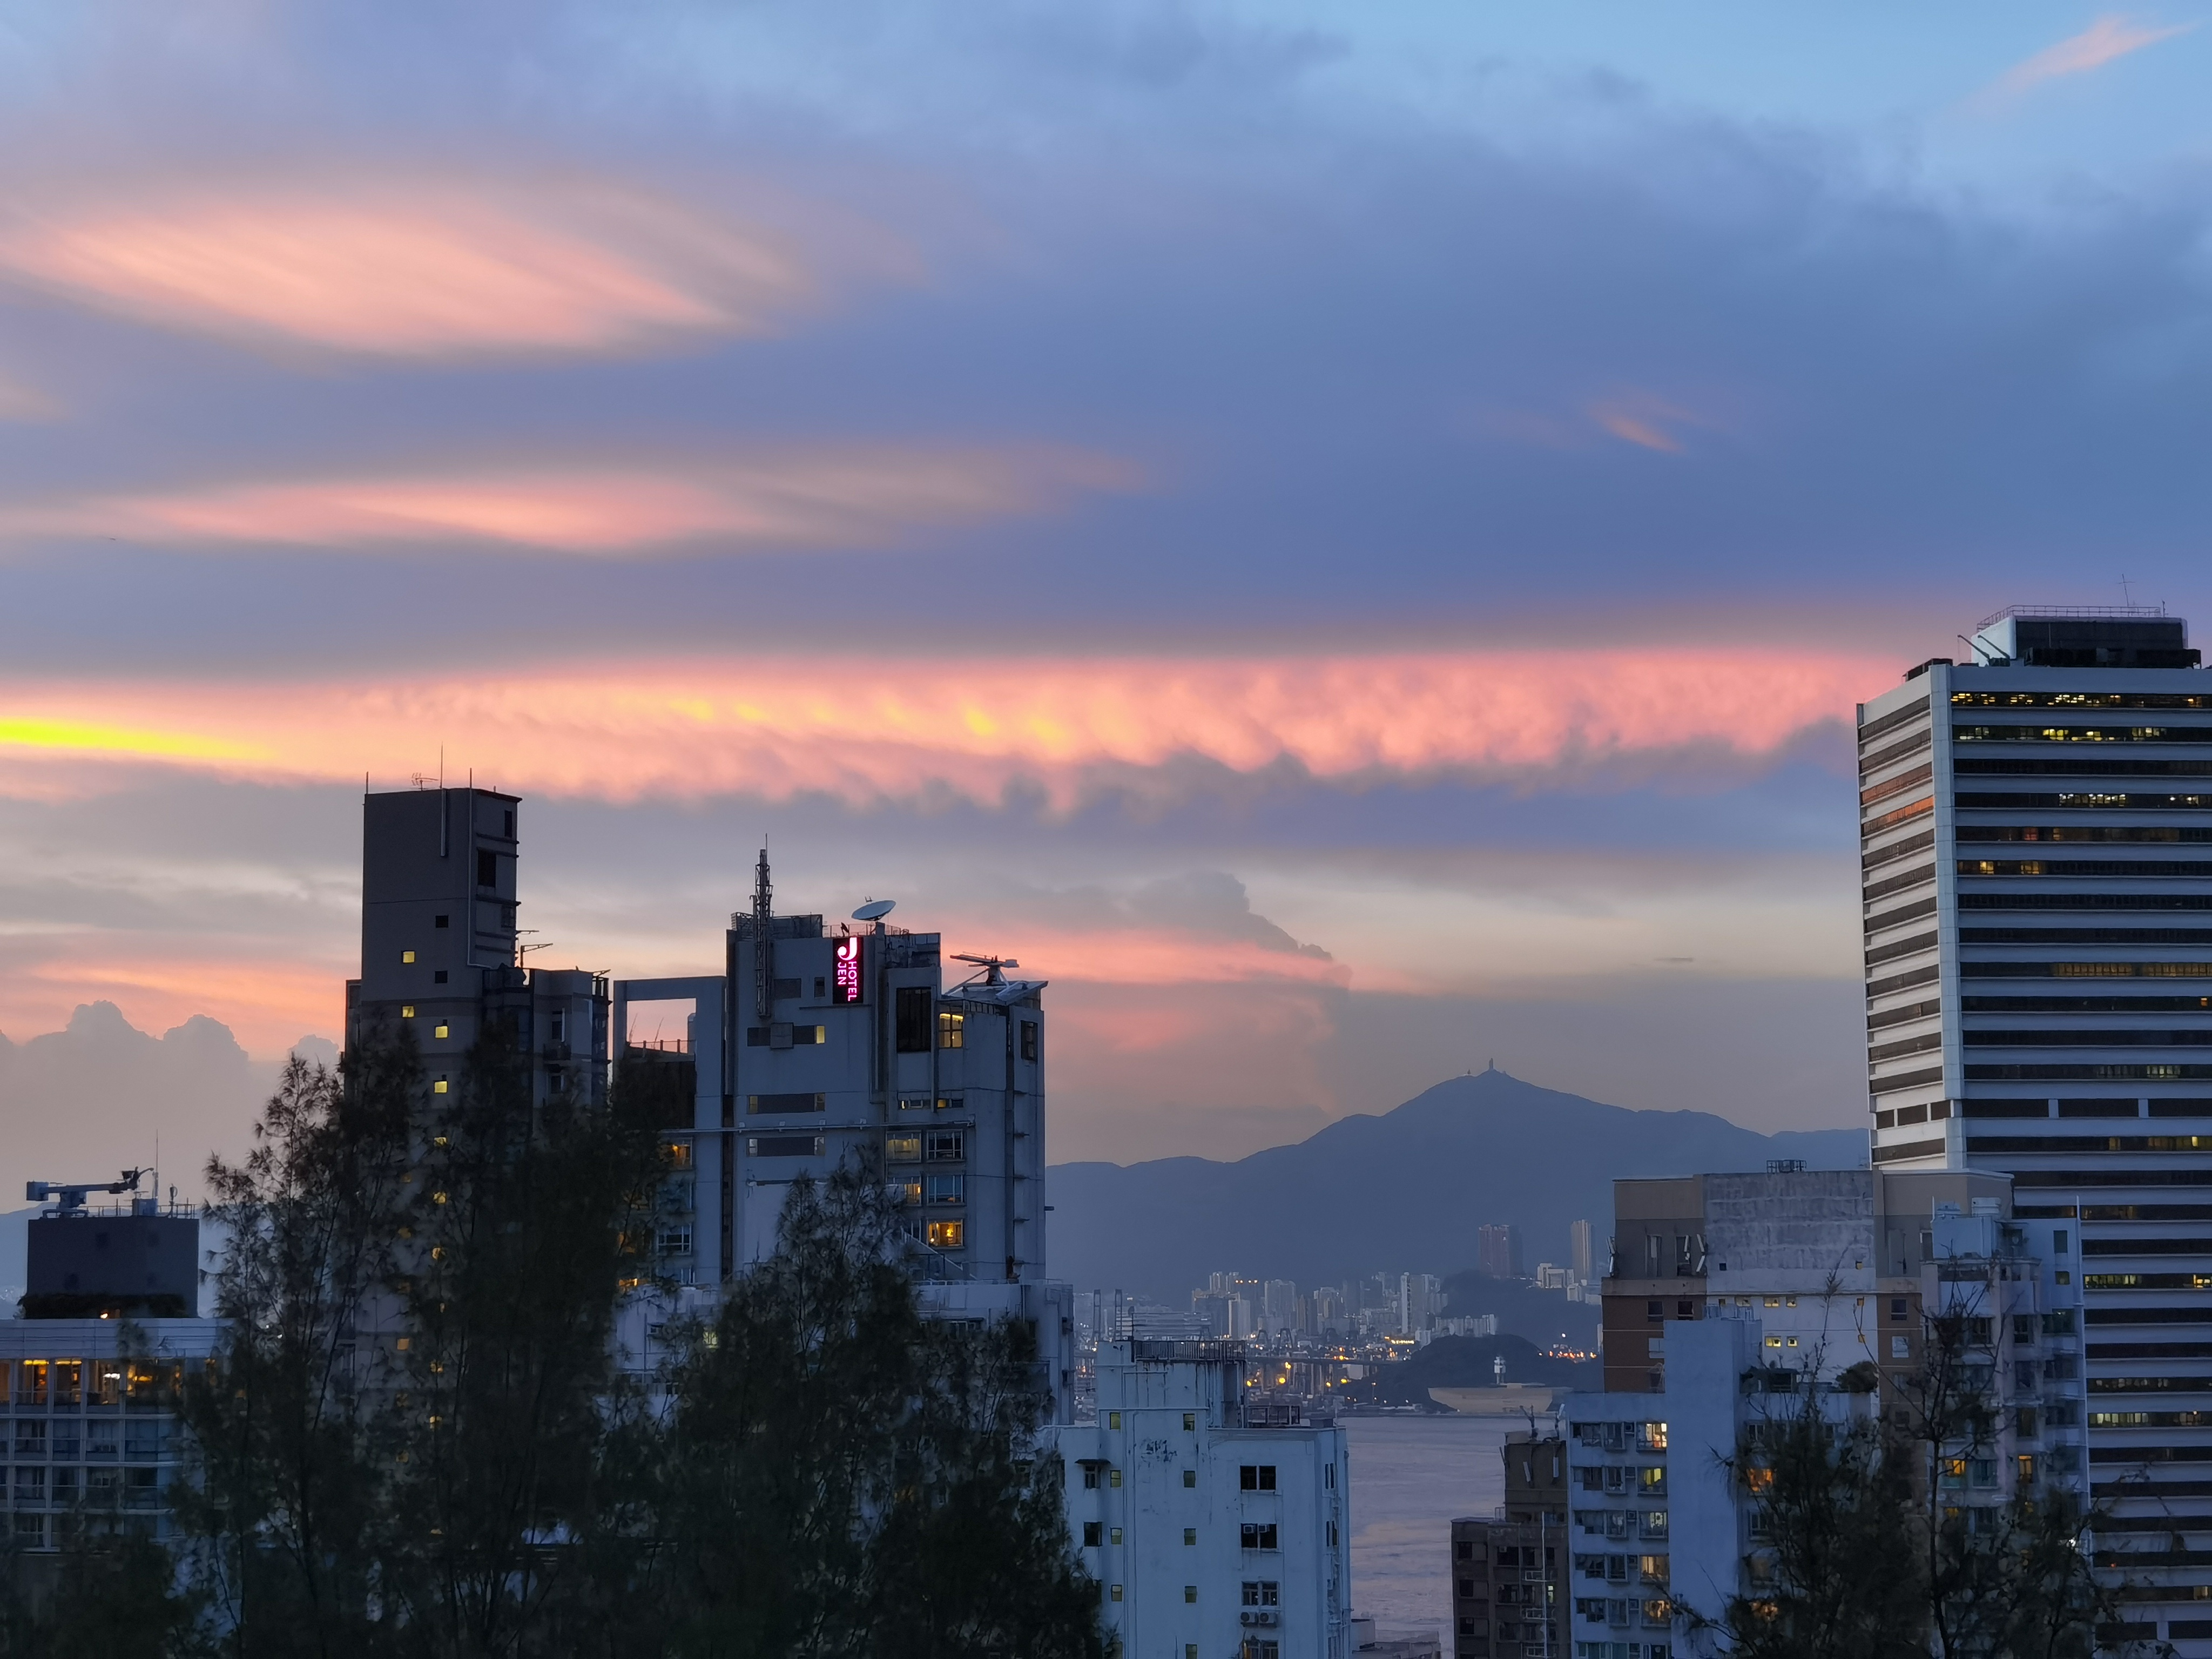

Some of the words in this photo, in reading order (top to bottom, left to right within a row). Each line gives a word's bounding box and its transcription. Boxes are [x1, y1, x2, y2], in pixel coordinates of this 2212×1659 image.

[838, 937, 857, 960] J
[838, 962, 847, 985] JEN
[848, 961, 857, 1001] HOTEL
